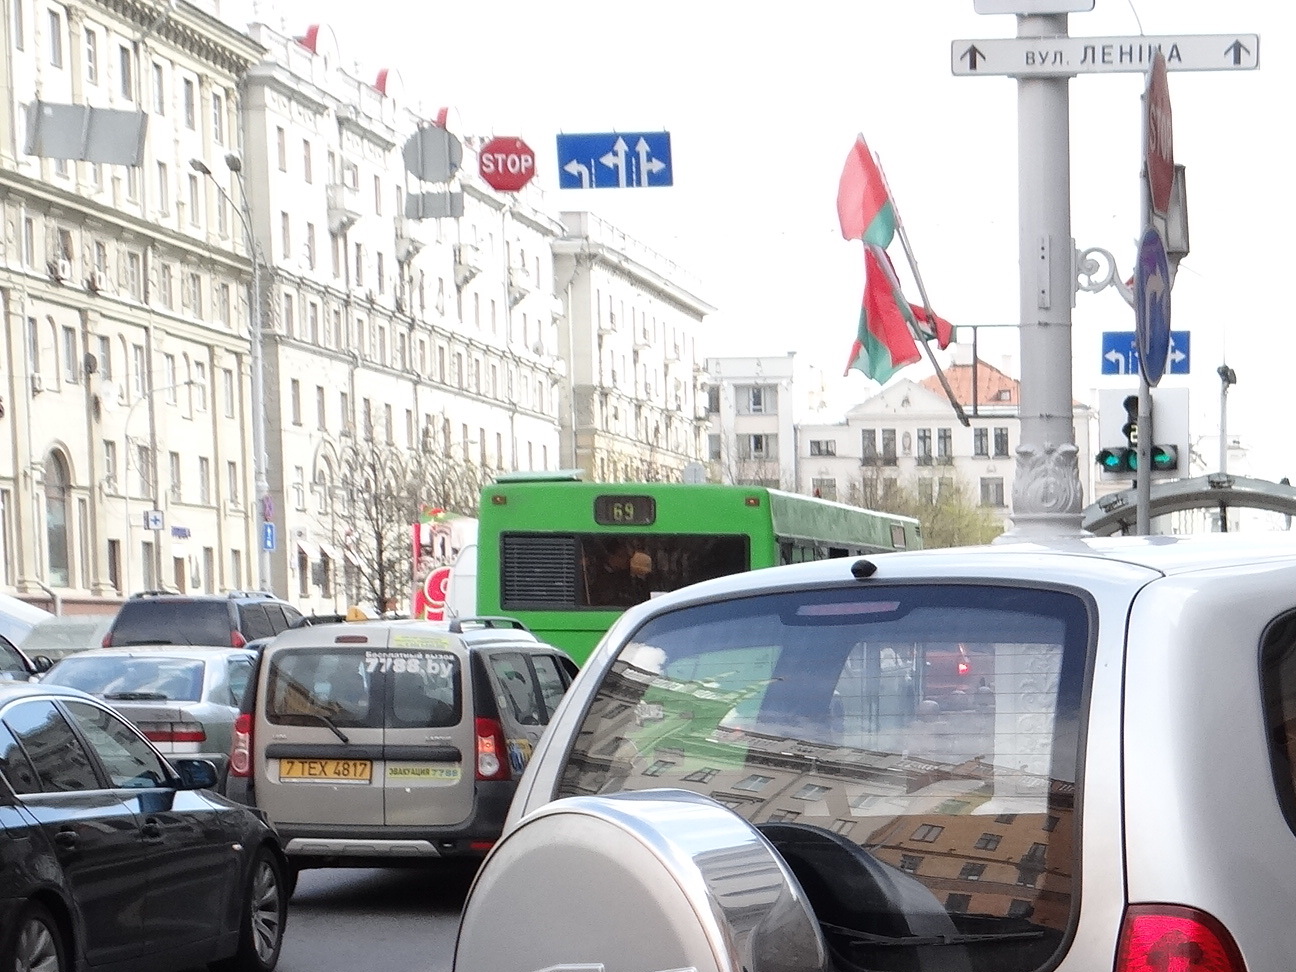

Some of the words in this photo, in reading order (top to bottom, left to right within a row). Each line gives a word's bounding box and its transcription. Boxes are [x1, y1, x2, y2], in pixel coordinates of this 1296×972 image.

[1025, 49, 1070, 67] ВУЛ.
[481, 153, 533, 174] STOP
[613, 502, 634, 521] 69
[365, 651, 423, 660] Бесплатный
[365, 657, 453, 678] 7788.by
[286, 760, 295, 774] 7
[298, 761, 330, 776] TEX
[333, 762, 368, 777] 4817
[389, 767, 431, 776] ЭВАКУАЦИЯ
[432, 768, 458, 778] 7788
